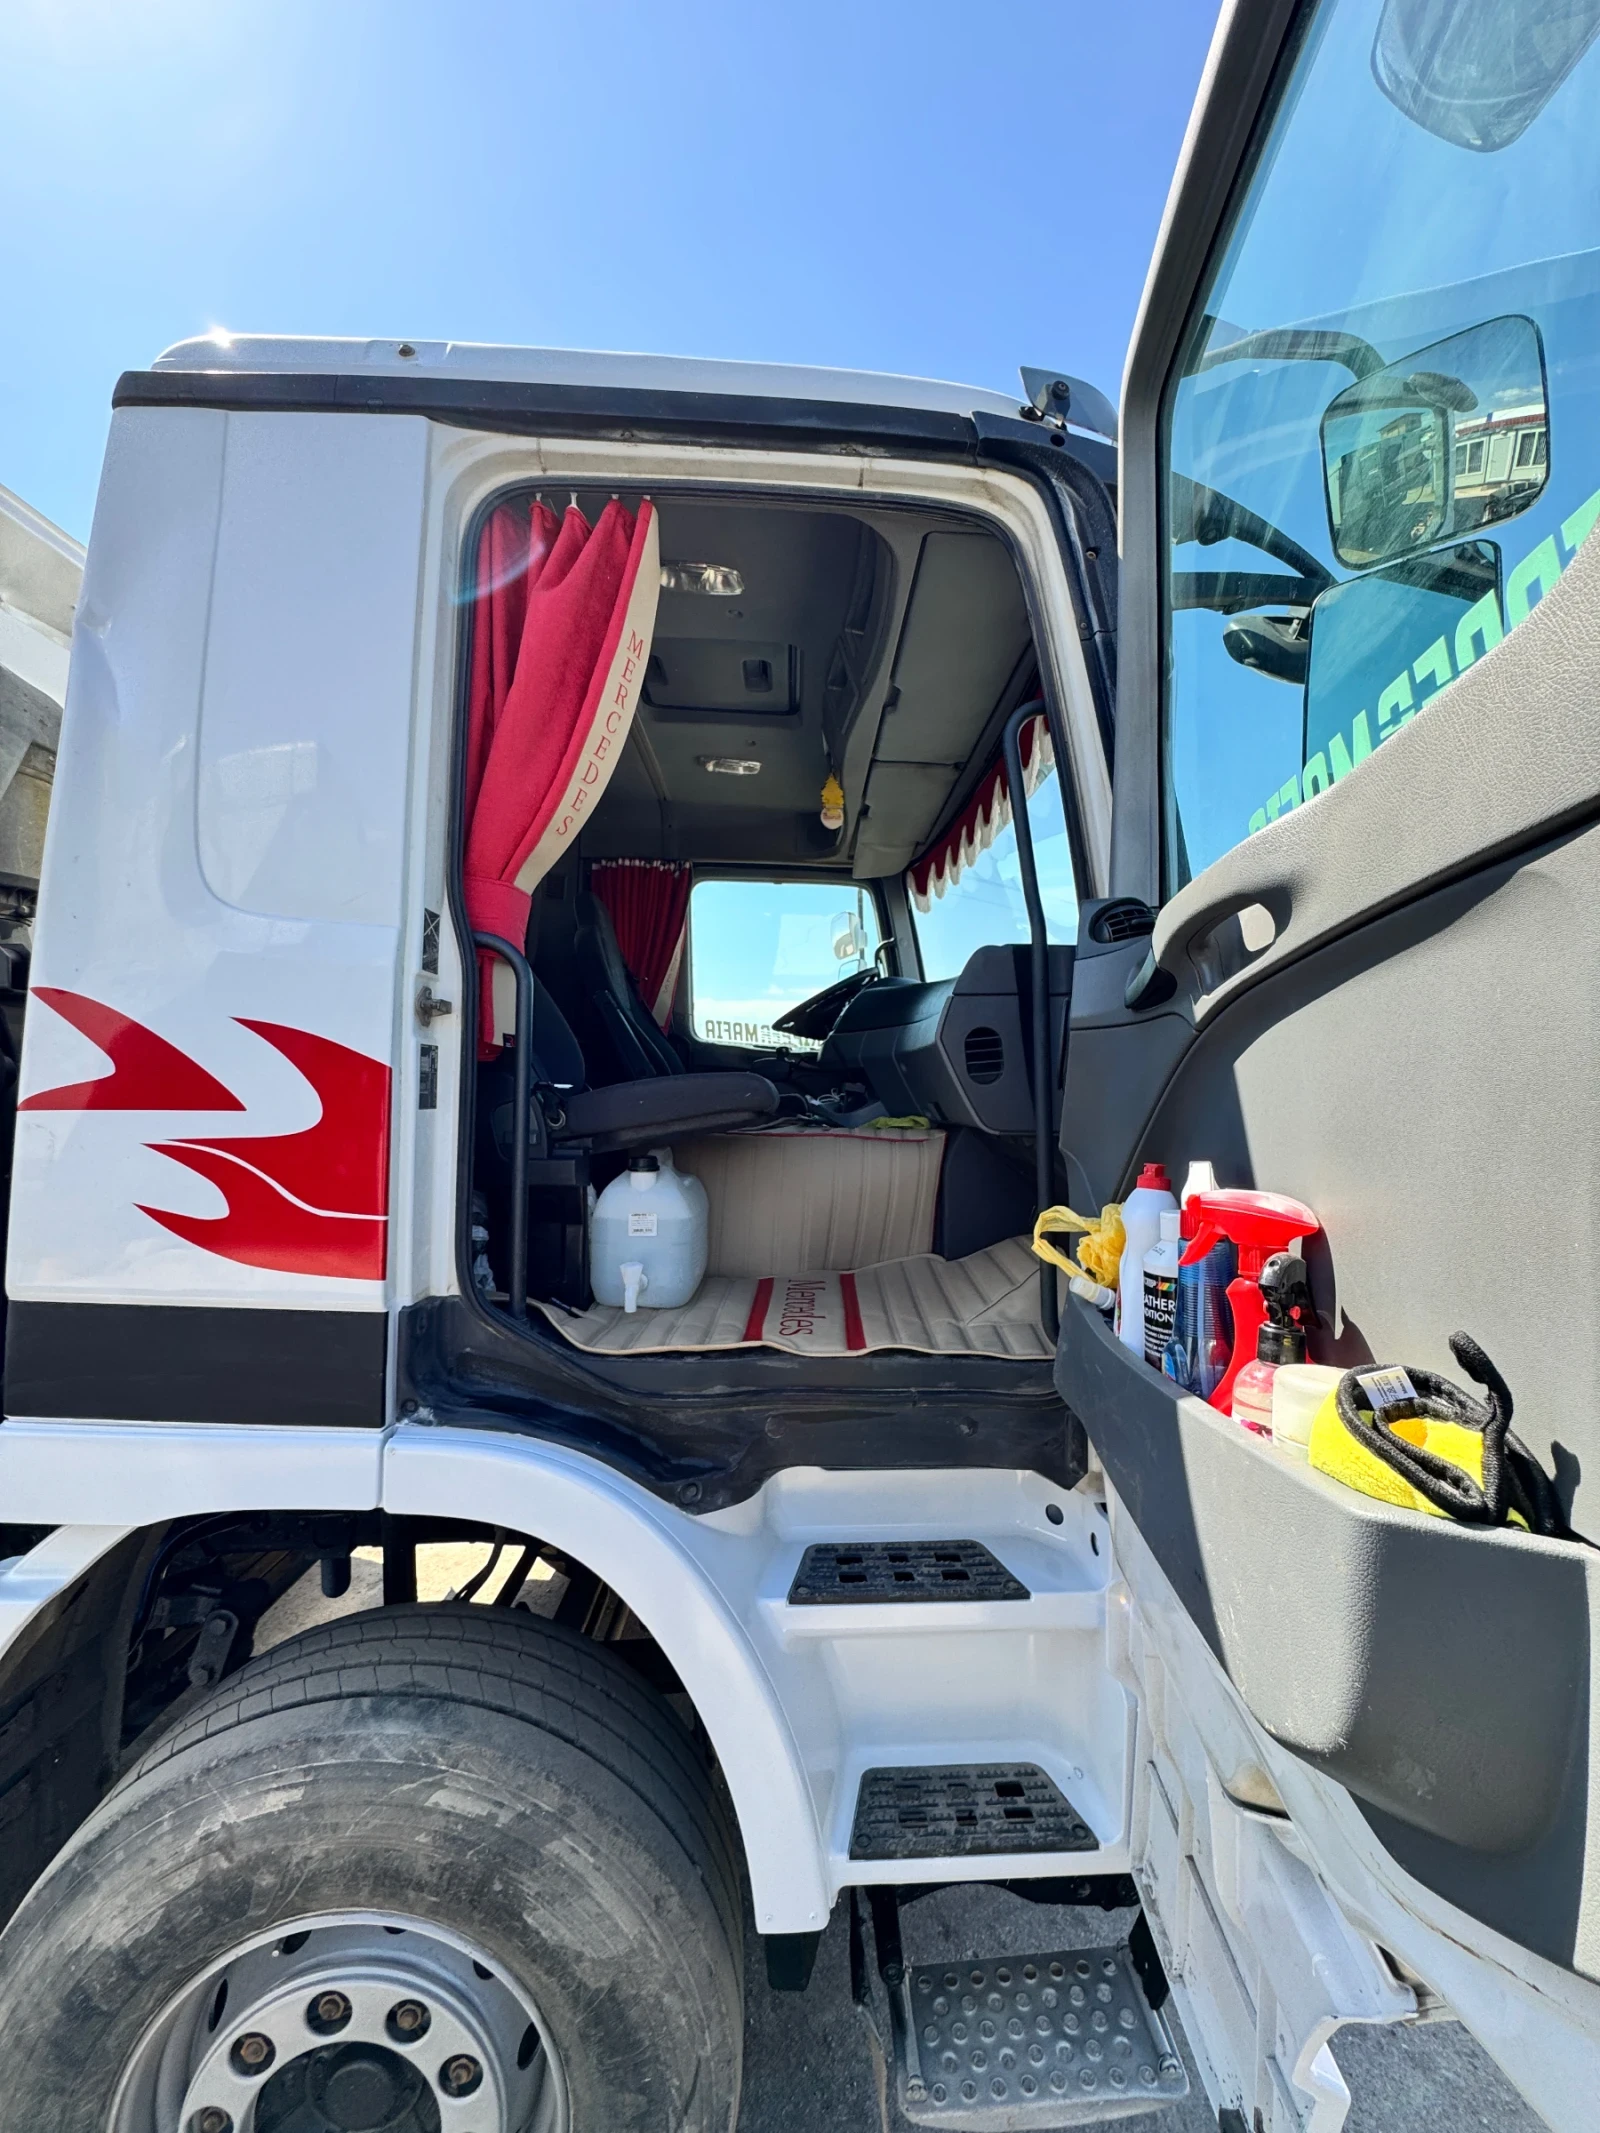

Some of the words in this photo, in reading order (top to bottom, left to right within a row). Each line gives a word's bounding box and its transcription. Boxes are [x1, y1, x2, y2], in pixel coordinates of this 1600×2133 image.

[554, 629, 645, 837] MERCEDES
[1144, 1293, 1176, 1312] ATHER
[1144, 1308, 1174, 1324] DITION
